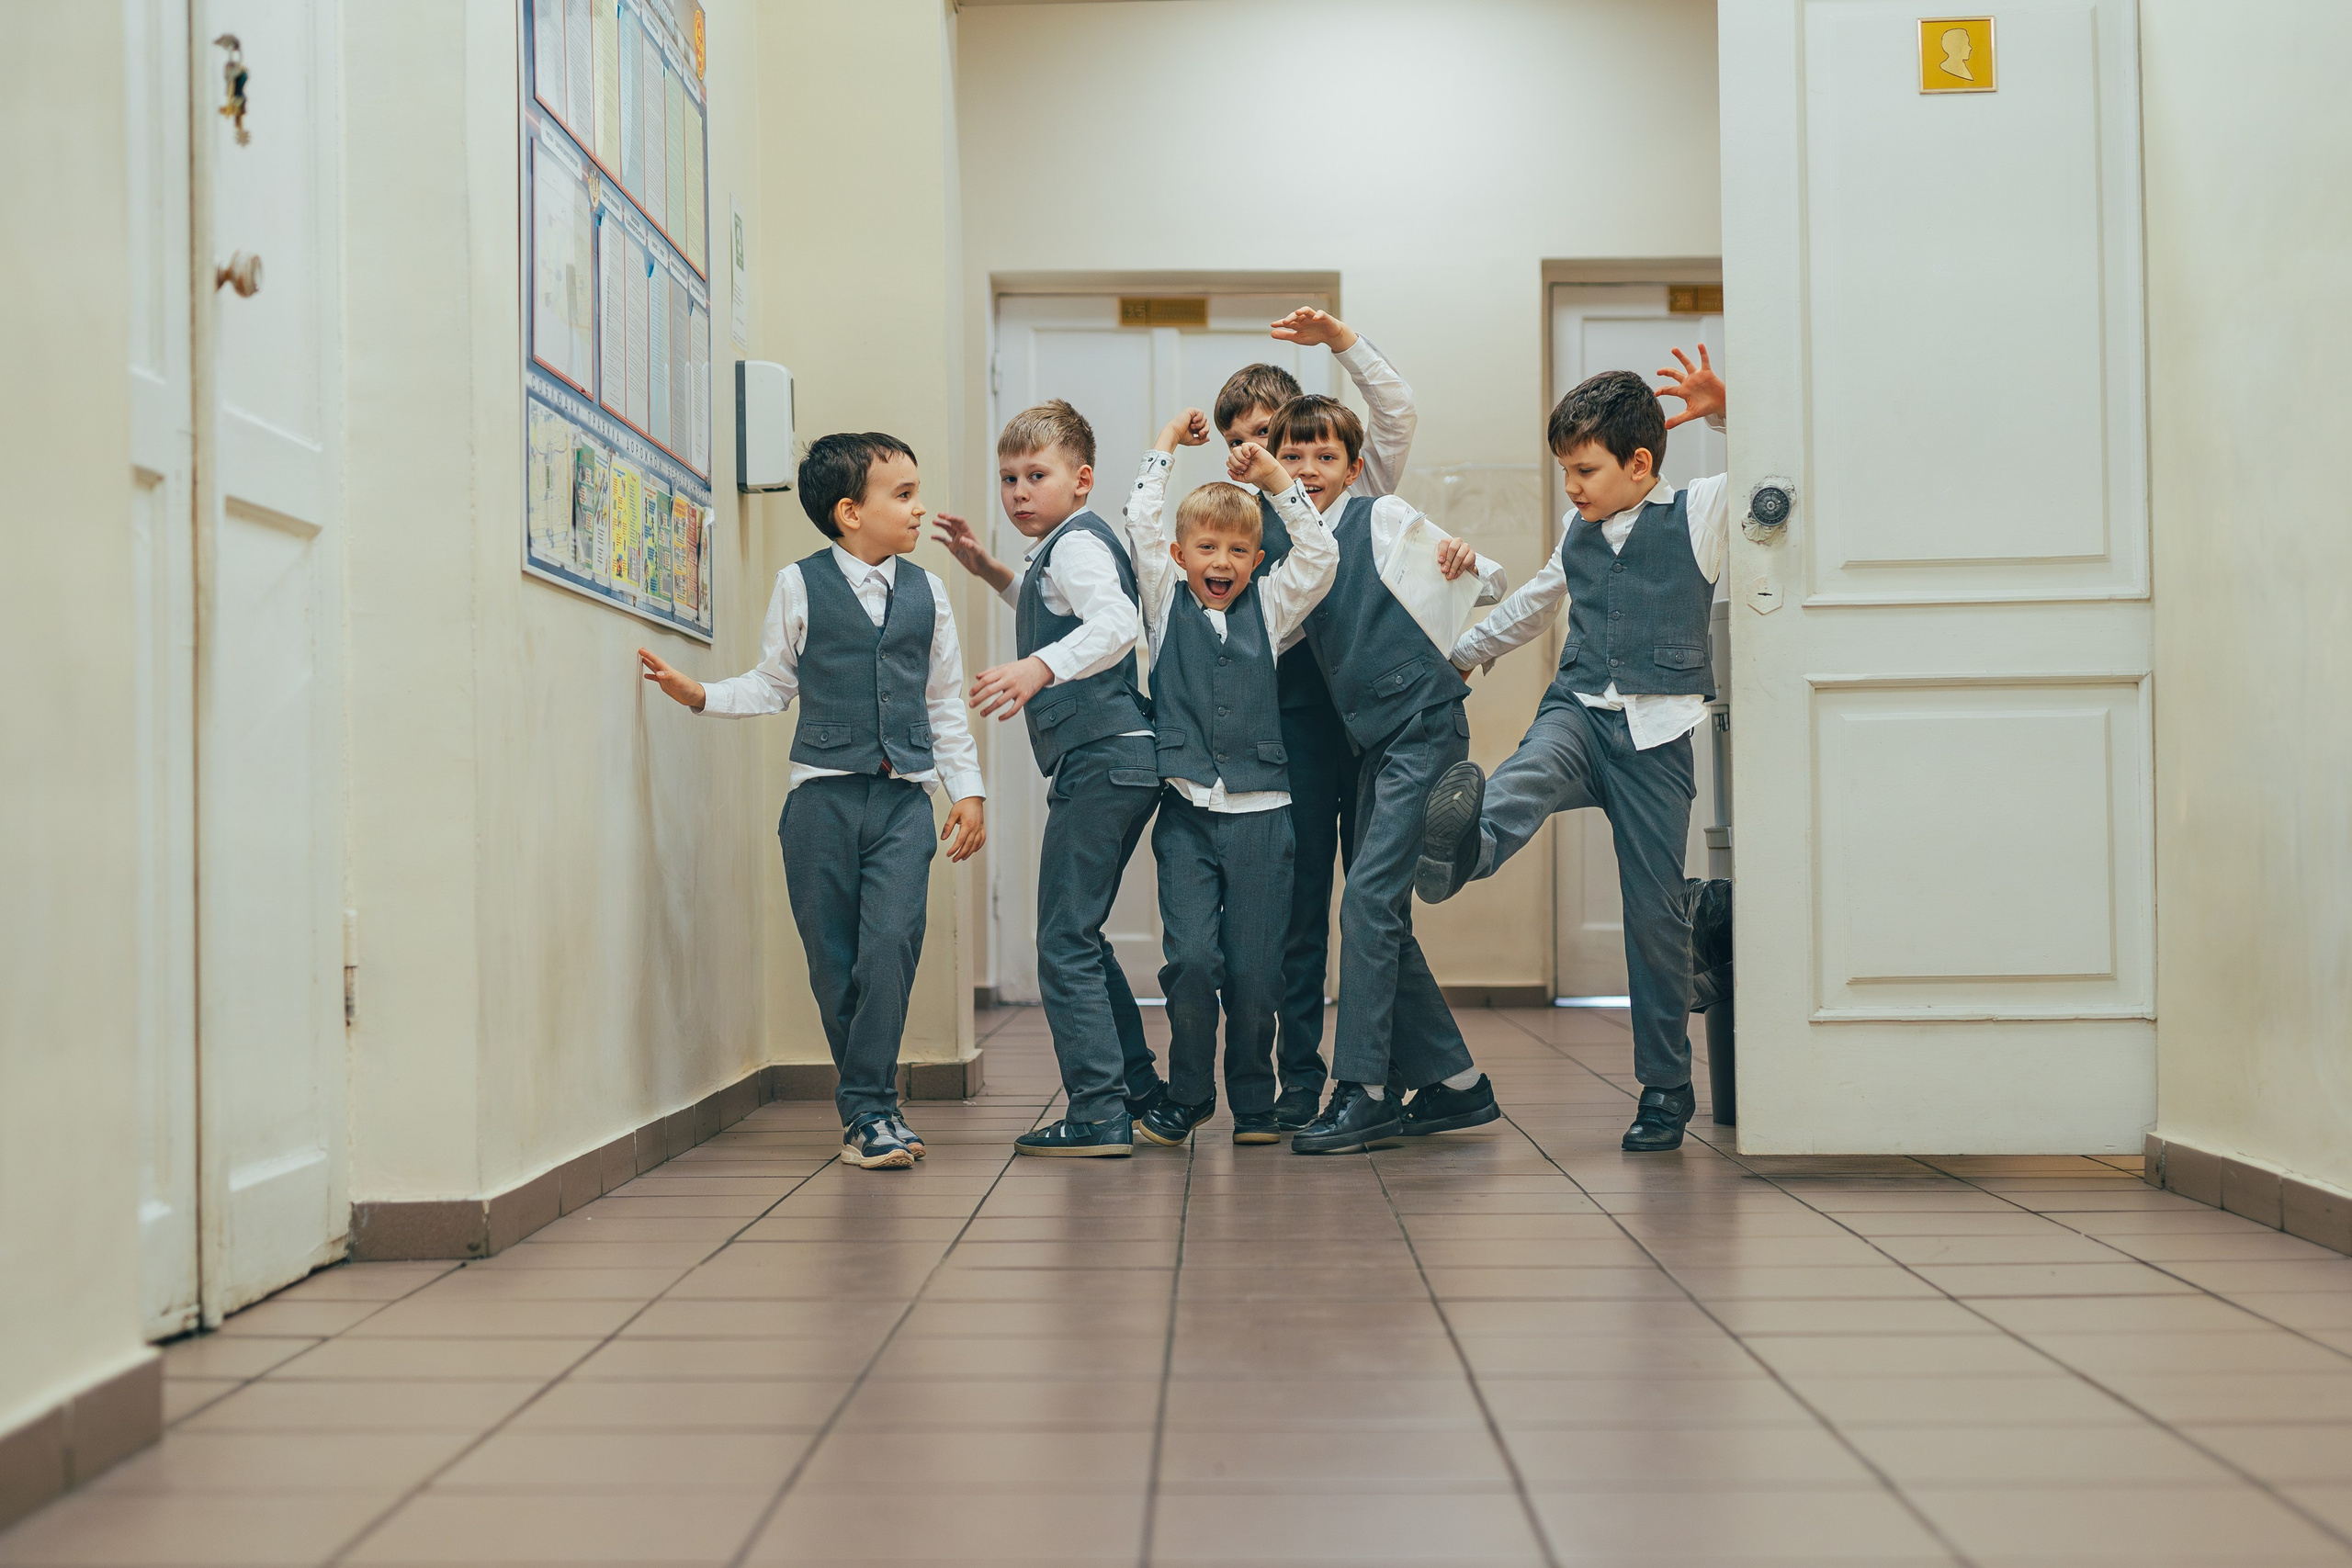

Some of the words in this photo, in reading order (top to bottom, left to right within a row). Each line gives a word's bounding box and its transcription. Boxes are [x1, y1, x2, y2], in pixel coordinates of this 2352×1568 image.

[531, 375, 581, 416] СОБЛЮДАЙ
[588, 411, 620, 444] ПРАВИЛА
[626, 437, 662, 470] ДОРОЖНОЙ
